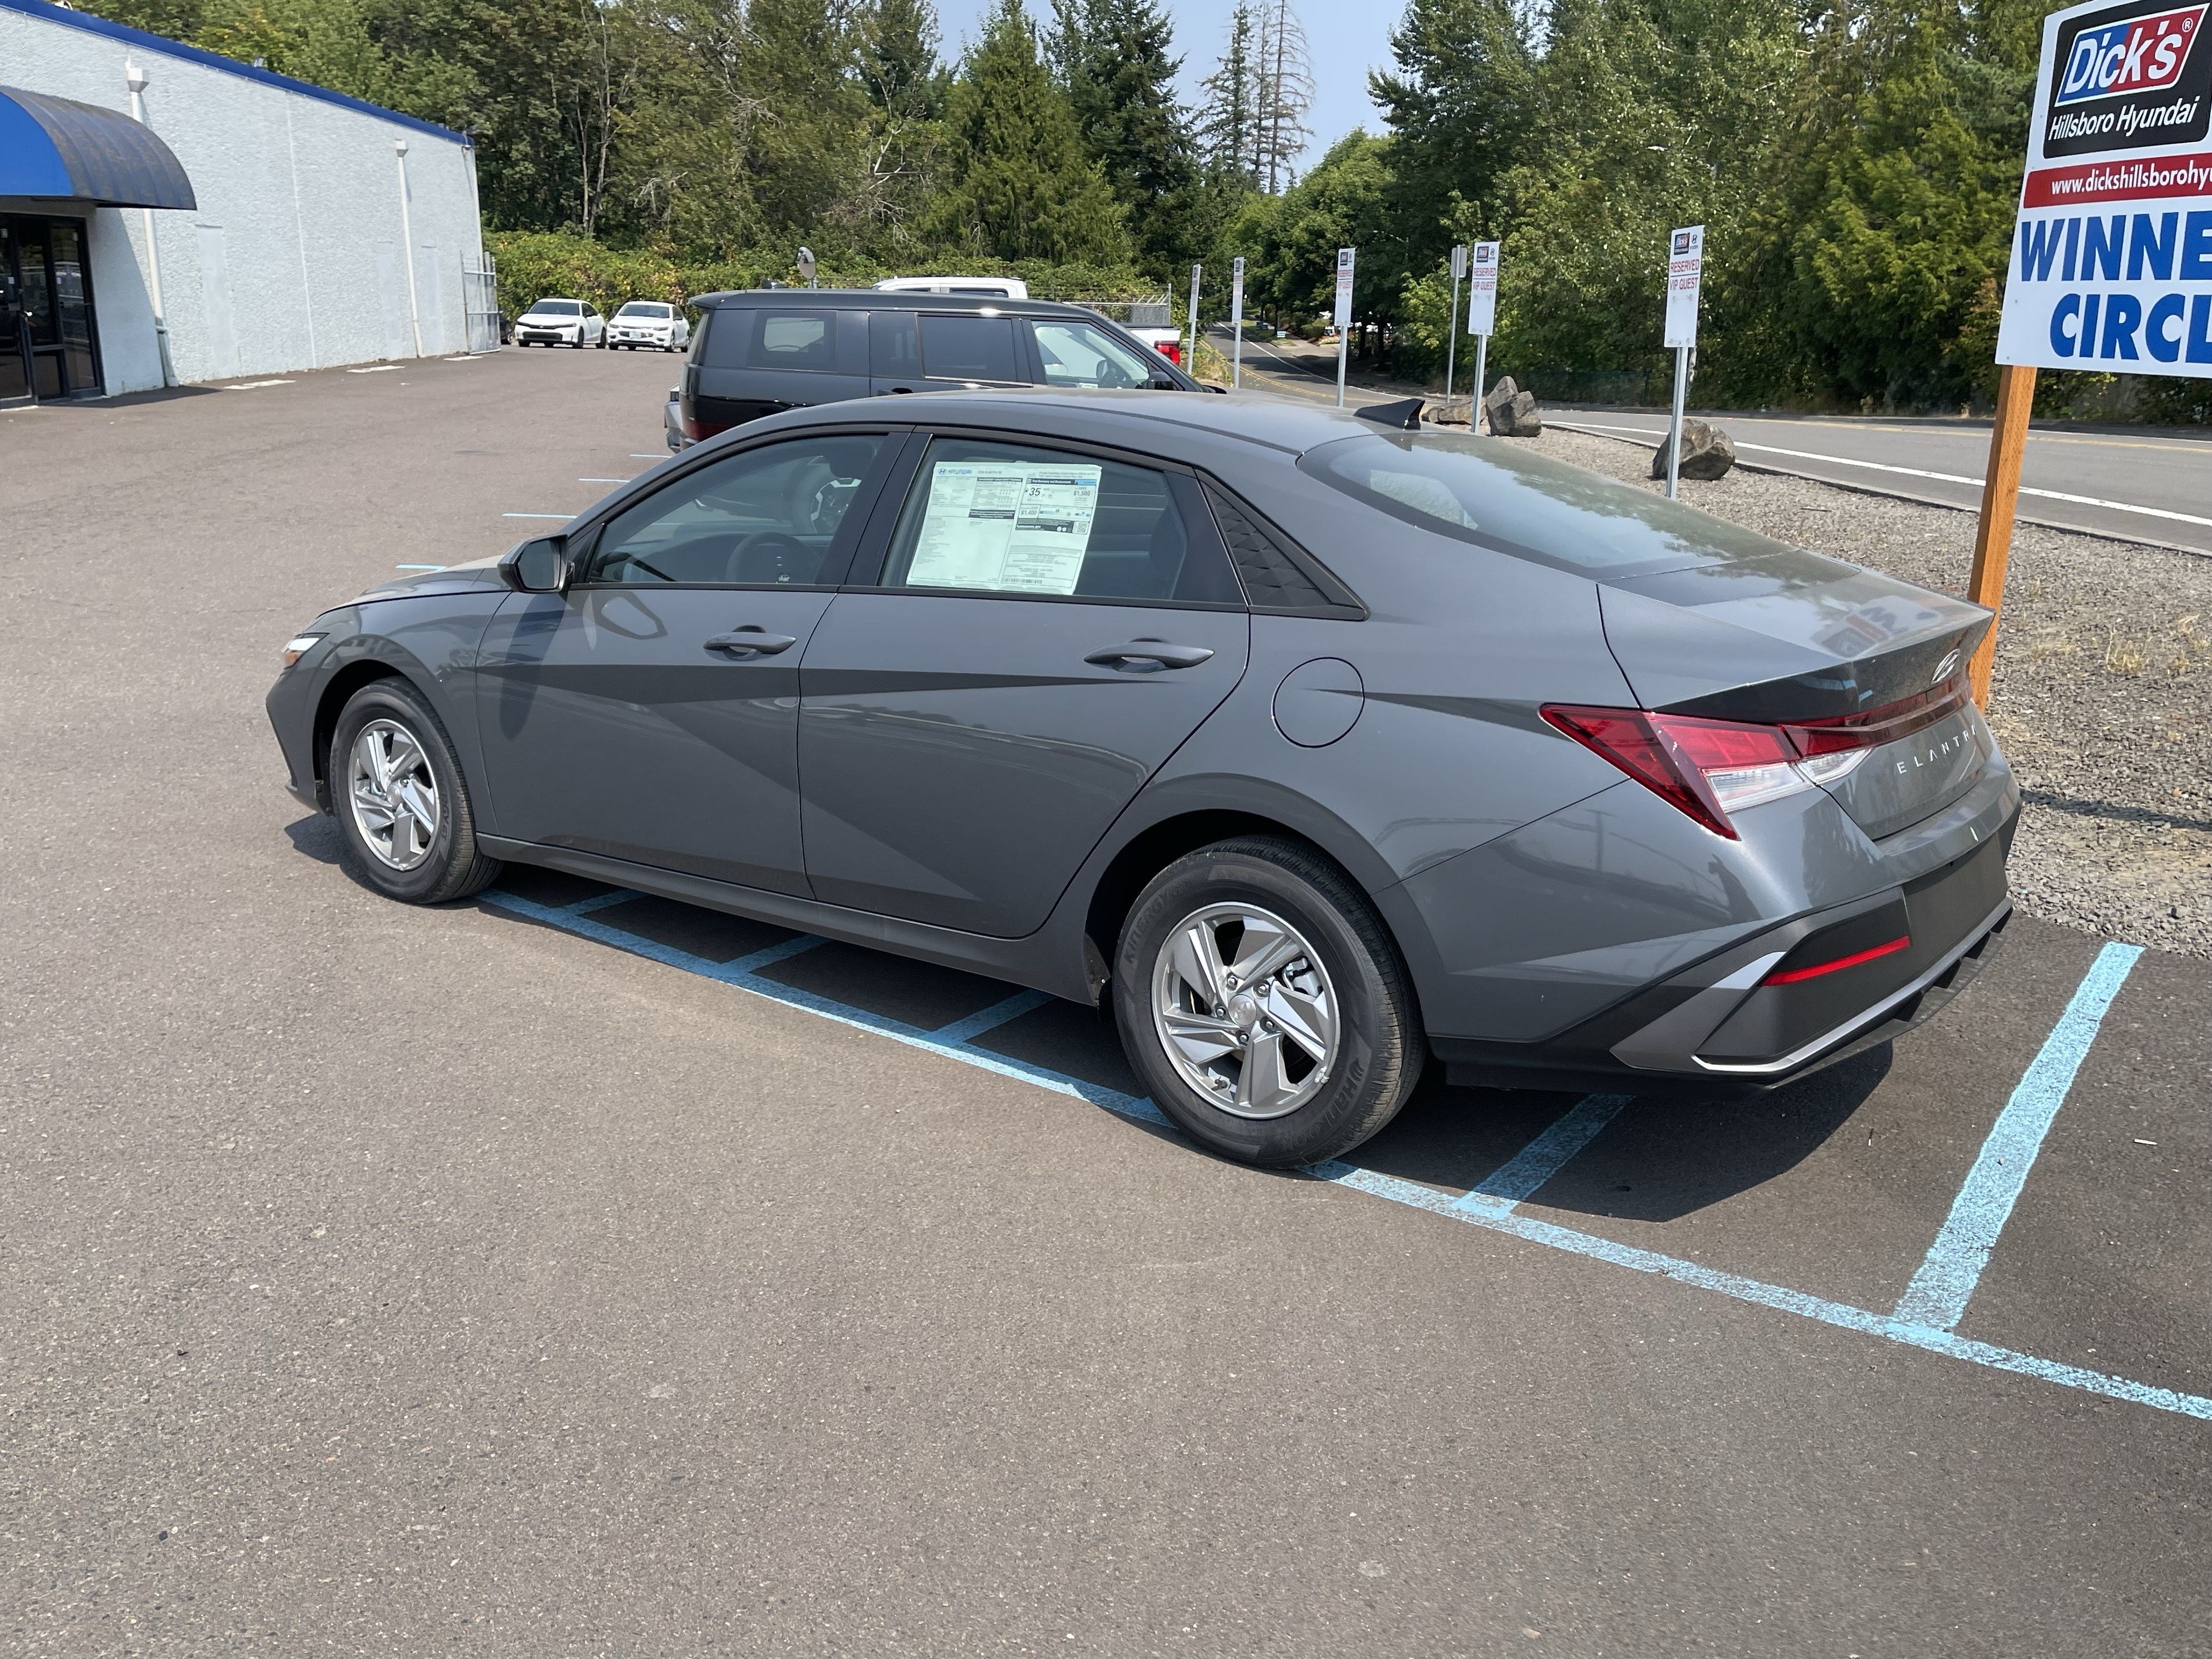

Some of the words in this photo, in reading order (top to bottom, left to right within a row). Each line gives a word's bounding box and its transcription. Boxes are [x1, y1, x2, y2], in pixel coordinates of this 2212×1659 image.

[2064, 20, 2182, 94] Dick's
[2048, 111, 2114, 140] Hillsboro
[2115, 95, 2200, 137] Hyundai
[1671, 259, 1699, 273] RESERVED
[2021, 211, 2212, 281] WINNE
[1669, 279, 1678, 290] VIP
[1679, 277, 1699, 290] GUEST
[2050, 293, 2212, 364] CIRCL
[1029, 487, 1042, 496] 35
